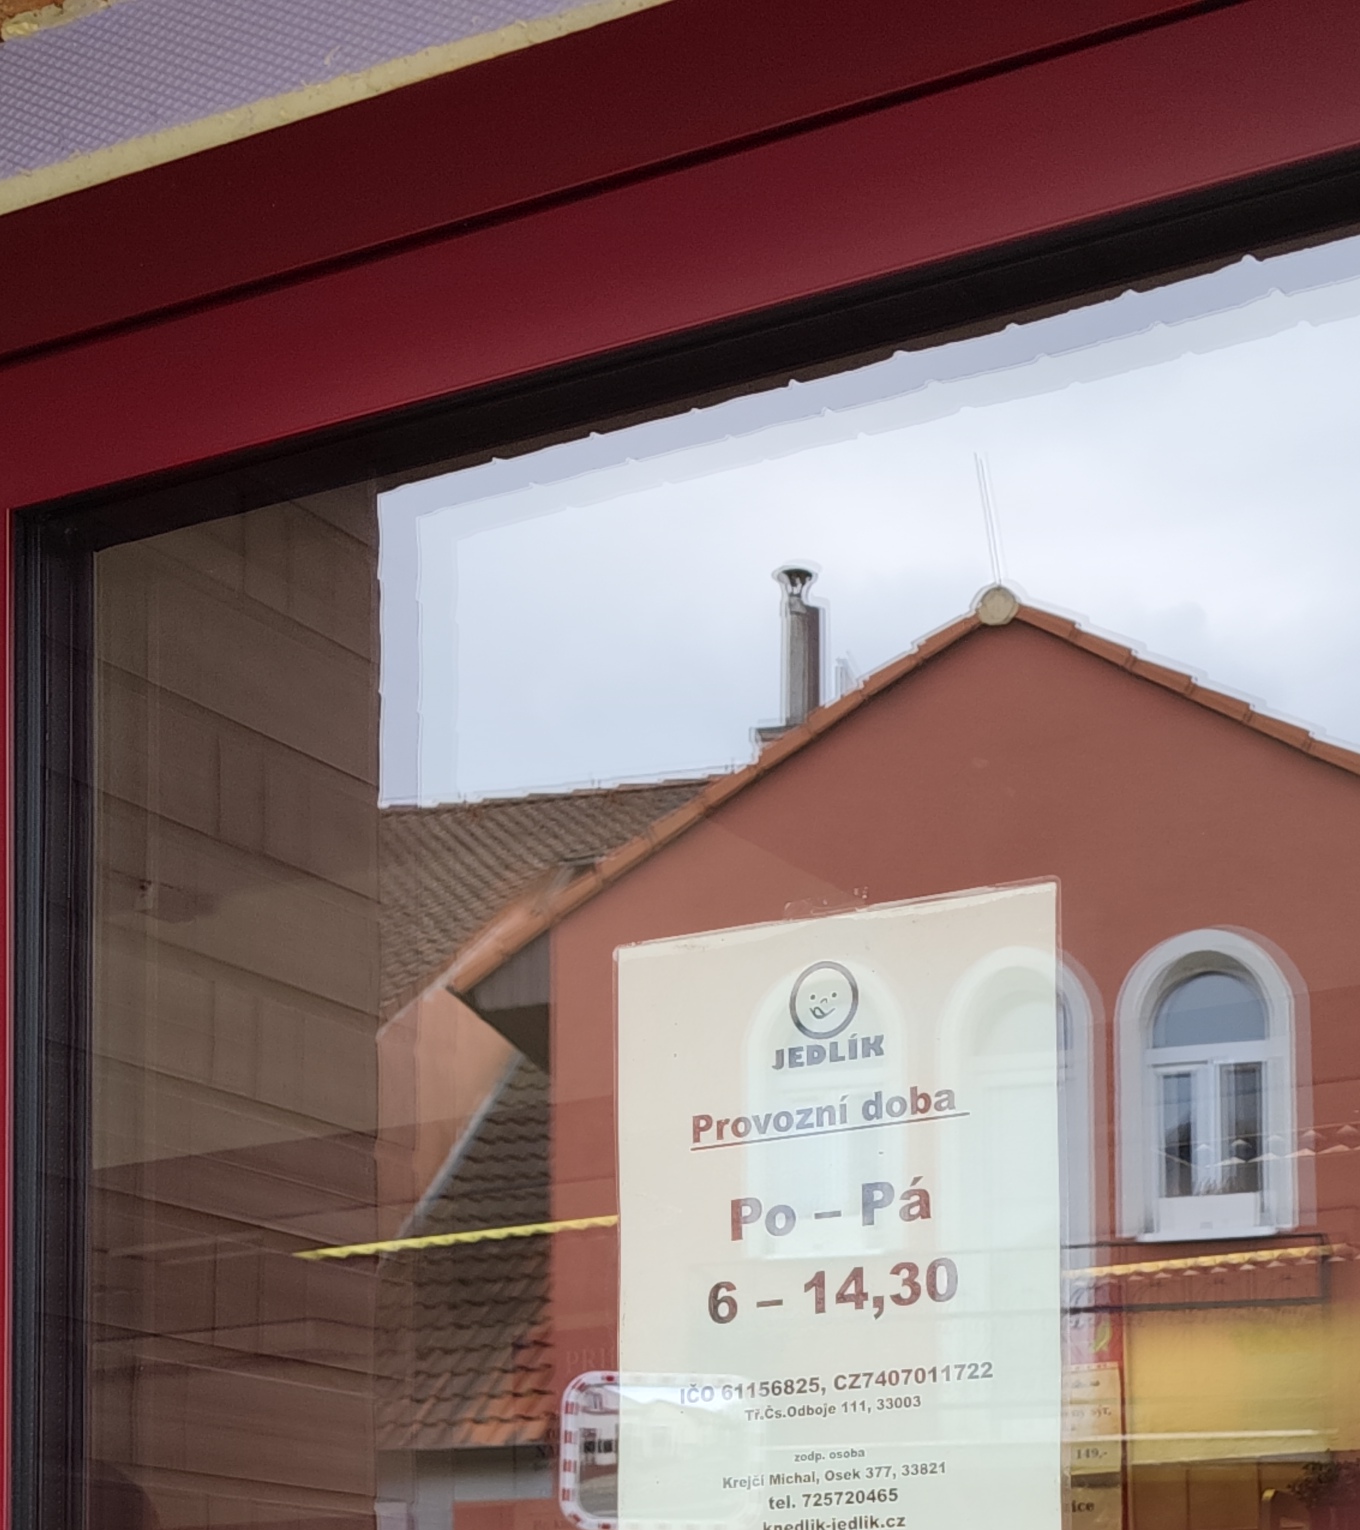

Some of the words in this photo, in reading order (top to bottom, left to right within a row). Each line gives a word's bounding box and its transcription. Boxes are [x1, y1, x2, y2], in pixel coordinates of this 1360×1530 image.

[771, 1033, 885, 1071] JEDLÍK
[691, 1094, 850, 1144] Provozní
[861, 1085, 956, 1122] doba
[730, 1197, 797, 1242] Po
[861, 1175, 932, 1227] Pá
[707, 1280, 738, 1324] 6
[803, 1257, 959, 1320] 14,30
[679, 1383, 715, 1405] IČO
[720, 1376, 828, 1403] 61156825,
[832, 1361, 994, 1391] CZ7407011722
[744, 1402, 837, 1422] Tř.Čs.Odboje
[840, 1399, 871, 1415] 111,
[876, 1395, 922, 1411] 33003
[793, 1450, 826, 1464] zodp.
[828, 1447, 866, 1460] osoba
[722, 1474, 765, 1491] Krejčí
[768, 1470, 820, 1487] Michal,
[824, 1467, 862, 1483] Osek
[865, 1465, 897, 1480] 377,
[901, 1461, 947, 1477] 33821
[767, 1494, 797, 1510] tel.
[801, 1487, 899, 1508] 725720465
